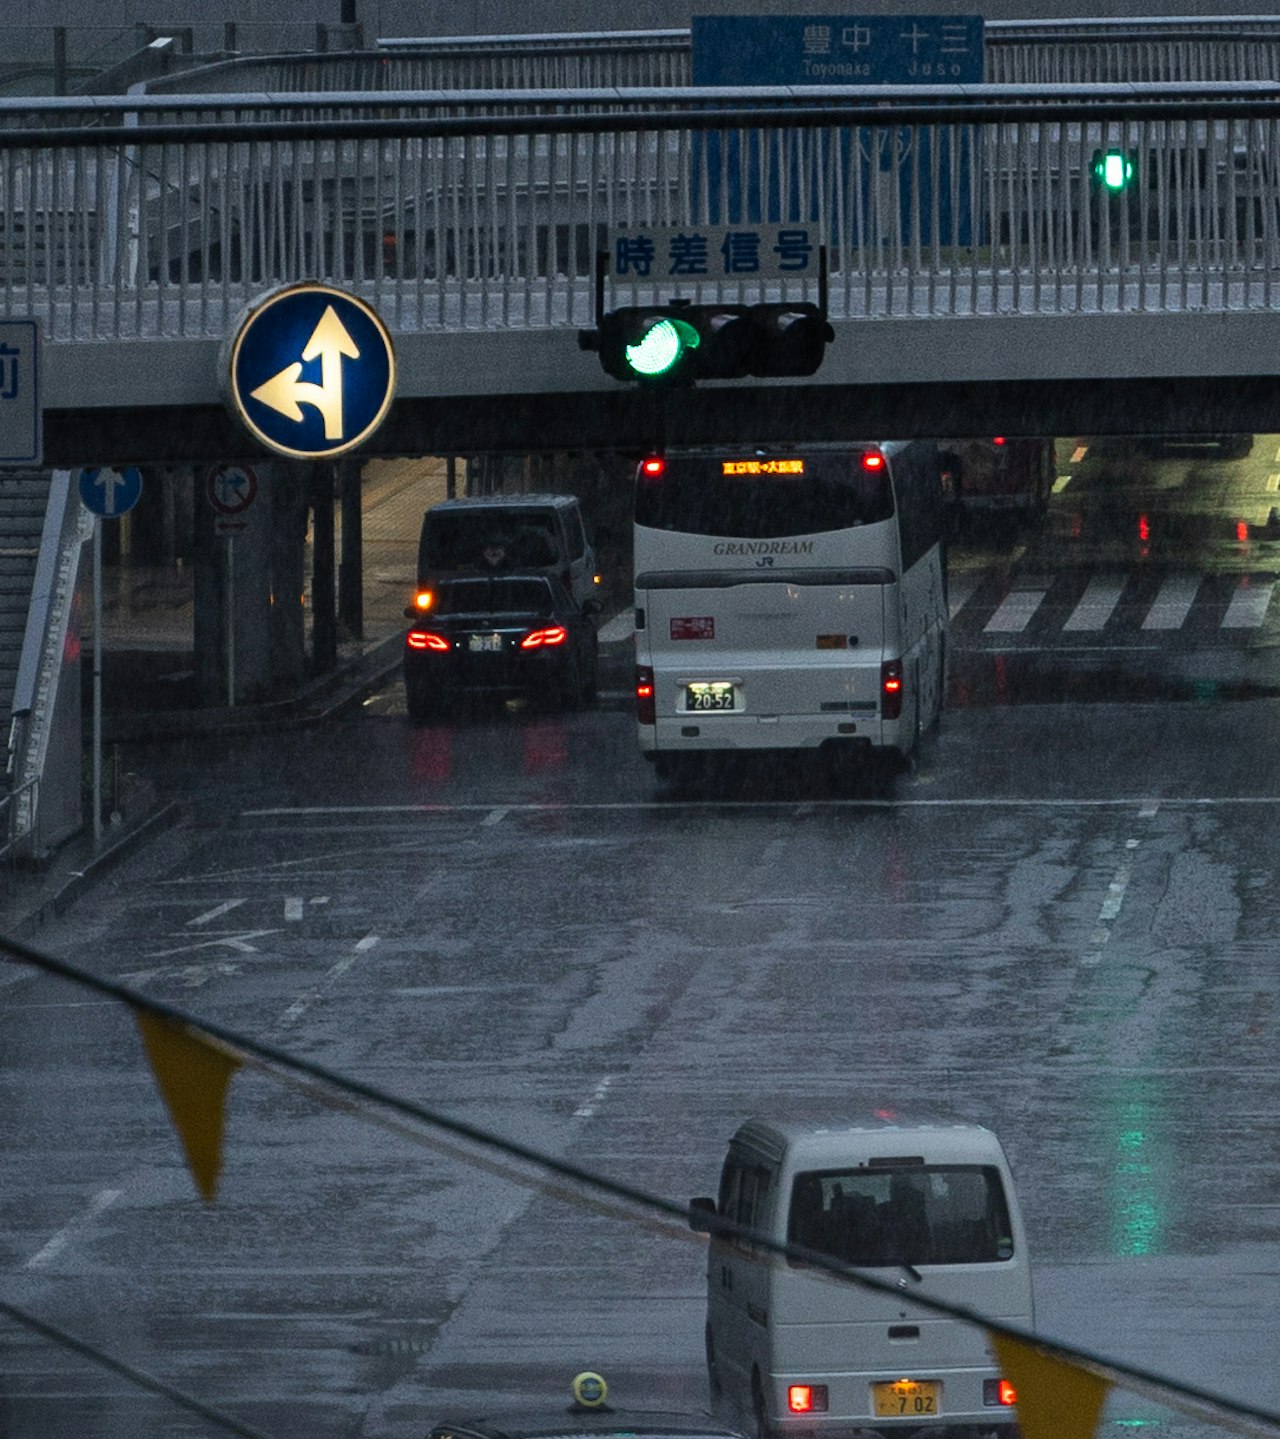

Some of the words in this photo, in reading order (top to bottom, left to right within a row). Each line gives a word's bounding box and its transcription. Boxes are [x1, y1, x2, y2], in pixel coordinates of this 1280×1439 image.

[802, 24, 870, 54] 豊中
[900, 24, 969, 53] 十三
[802, 59, 870, 77] Toyonaka
[907, 59, 961, 77] Juso
[615, 230, 813, 276] 時差信号
[713, 541, 814, 556] GRANDREAM
[755, 557, 774, 567] JR
[694, 692, 732, 710] 20-52
